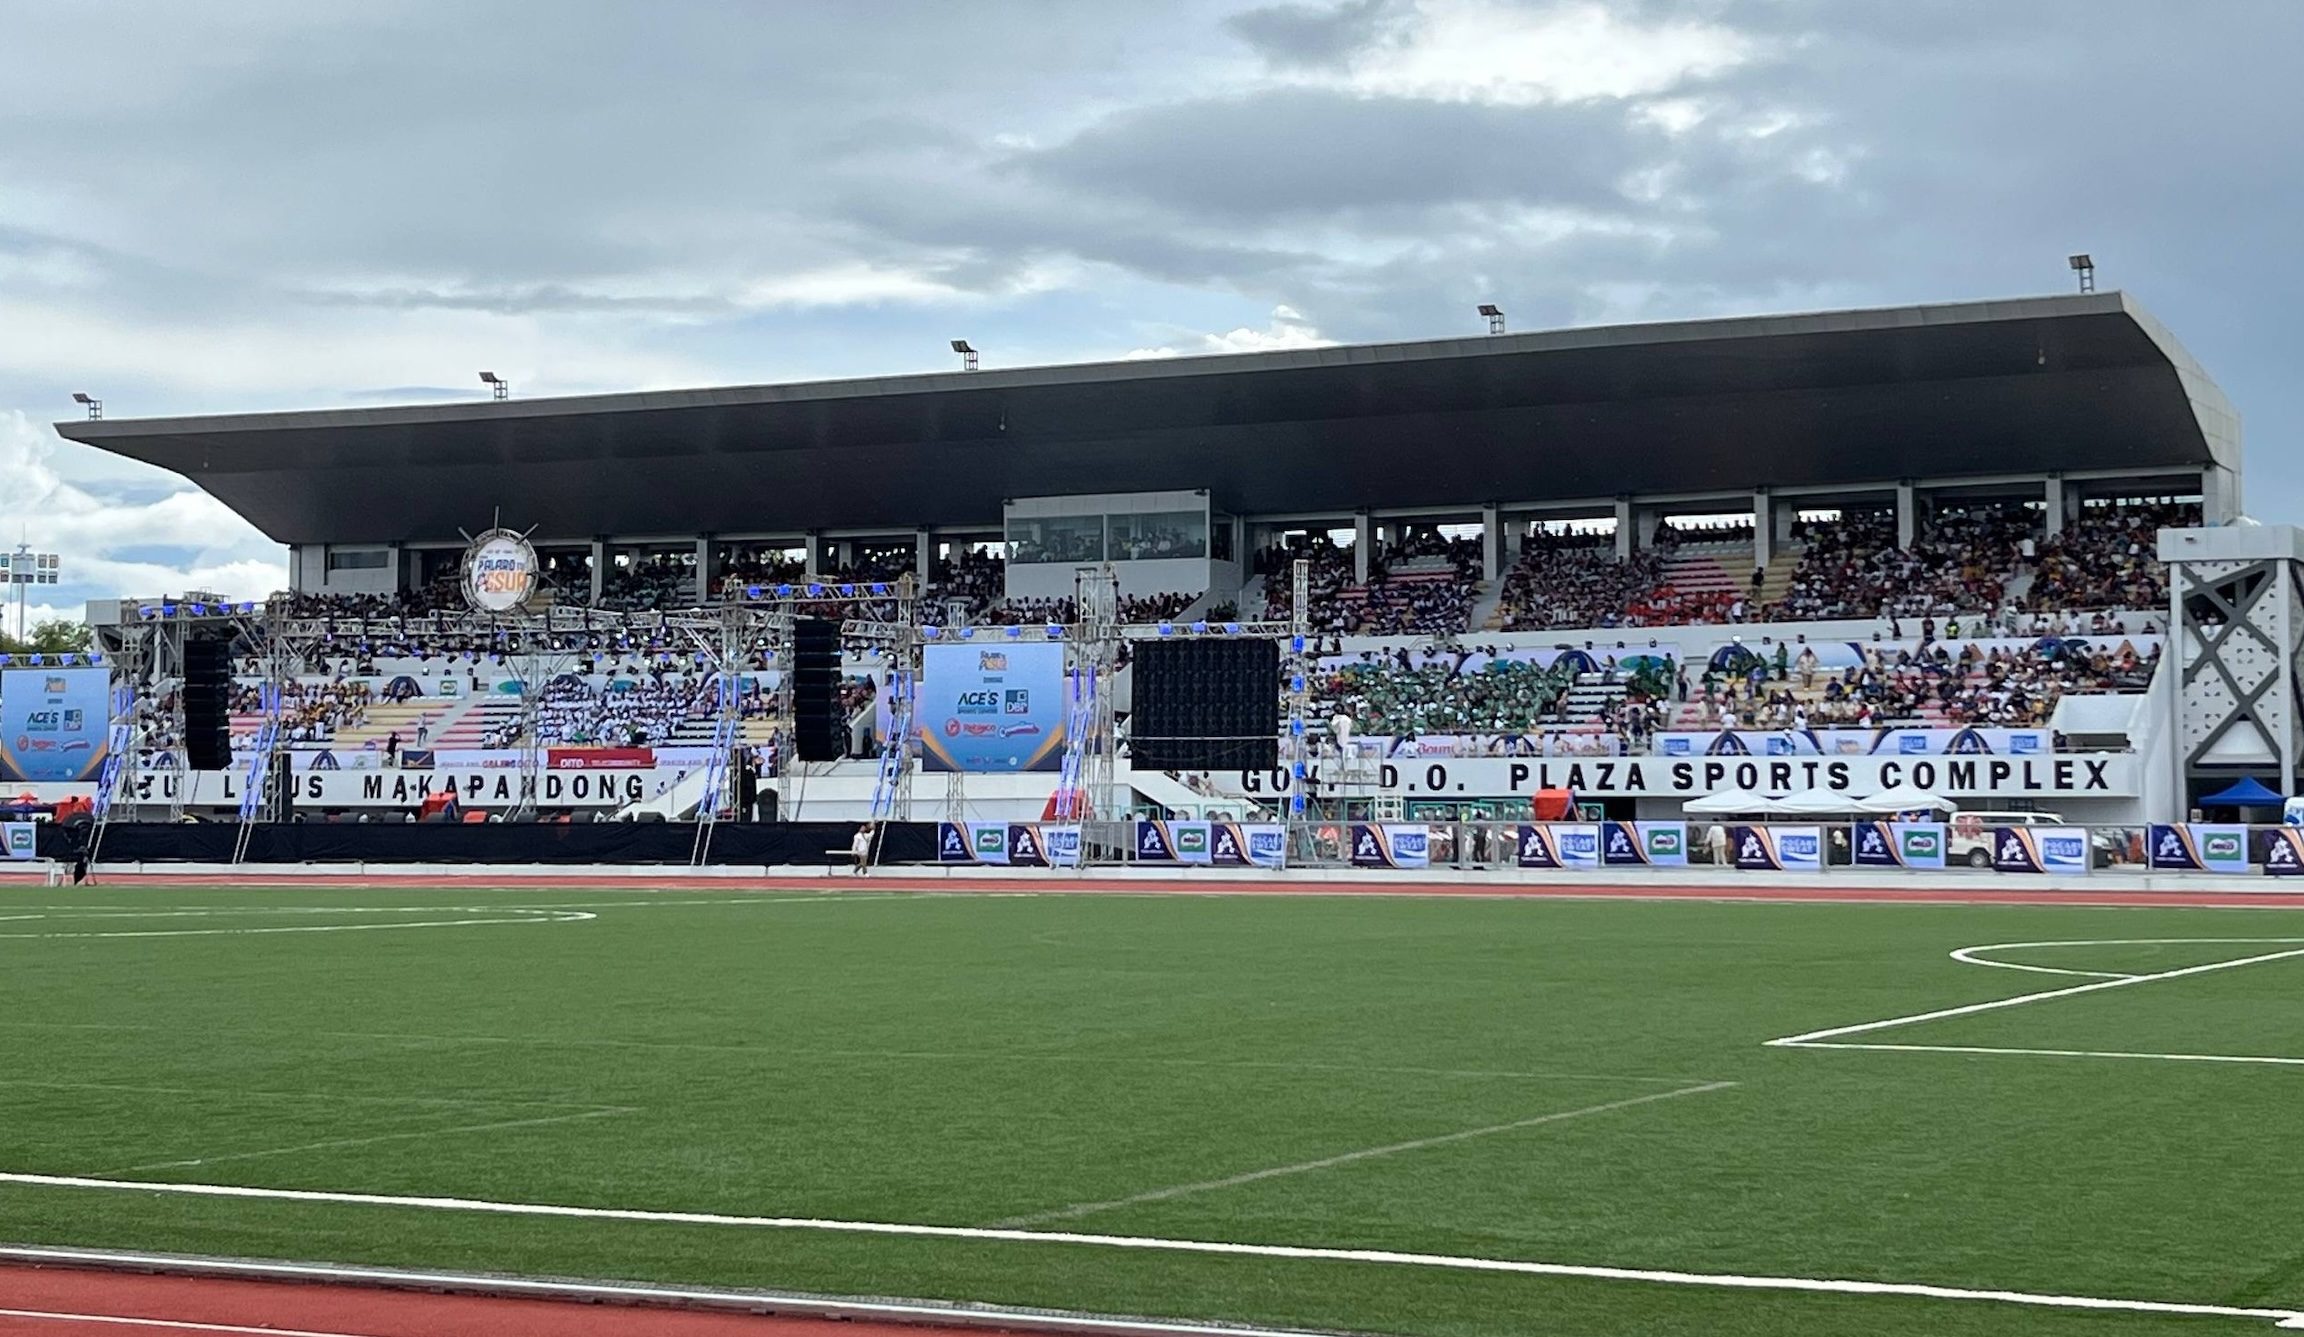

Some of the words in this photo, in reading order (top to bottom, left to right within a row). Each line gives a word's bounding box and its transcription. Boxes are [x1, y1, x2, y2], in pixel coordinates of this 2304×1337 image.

[958, 689, 999, 705] ACE'S
[224, 775, 323, 798] LUS
[1380, 764, 1464, 792] D.O.
[1510, 762, 1646, 791] PLAZA
[1672, 761, 1850, 791] SPORTS
[1880, 759, 2110, 791] COMPLEX
